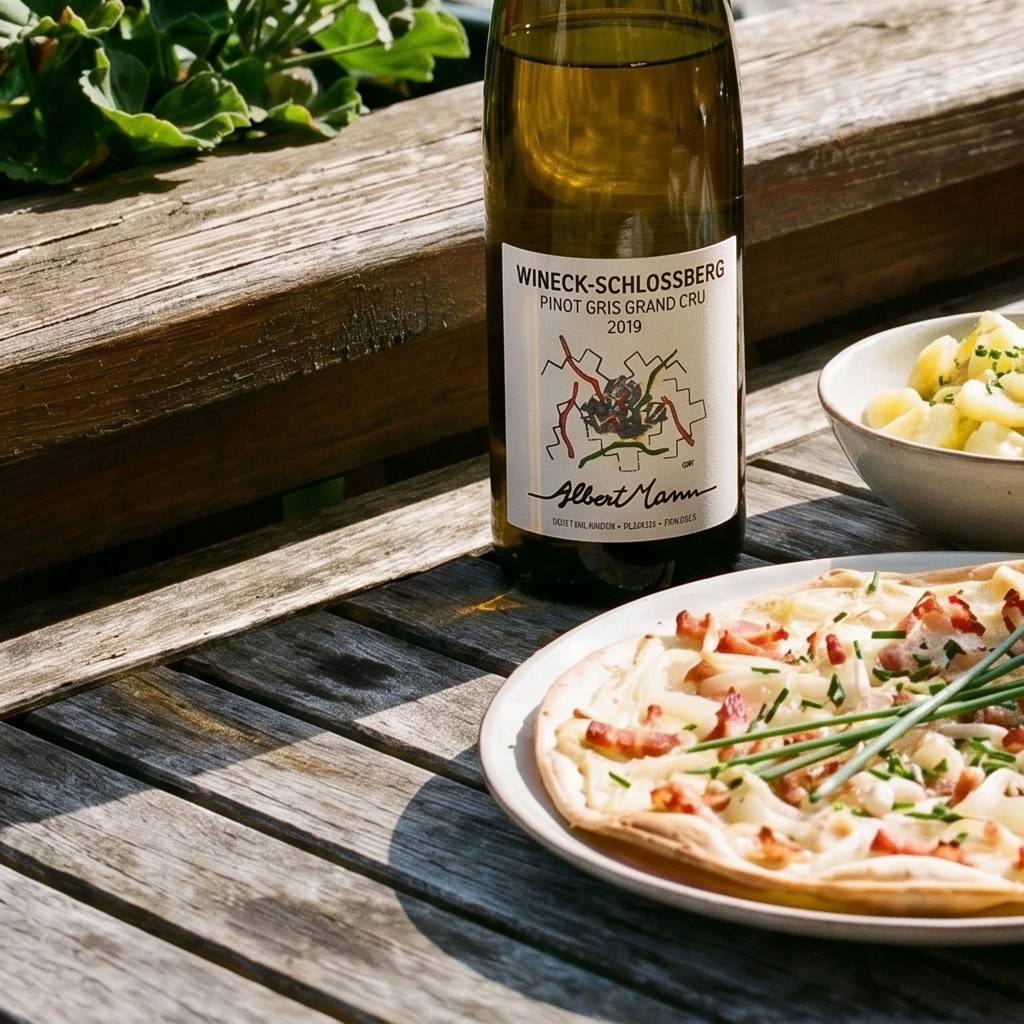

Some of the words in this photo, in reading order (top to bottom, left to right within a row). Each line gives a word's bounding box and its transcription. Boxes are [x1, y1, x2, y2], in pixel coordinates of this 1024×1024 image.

[516, 259, 725, 294] WINECK-SCHLOSSBERG
[540, 294, 582, 314] PINOT
[586, 300, 621, 315] GRIS
[625, 296, 676, 314] GRAND
[679, 289, 706, 310] CRU
[607, 319, 642, 334] 2019
[530, 479, 630, 509] Albert
[624, 478, 717, 509] Mann
